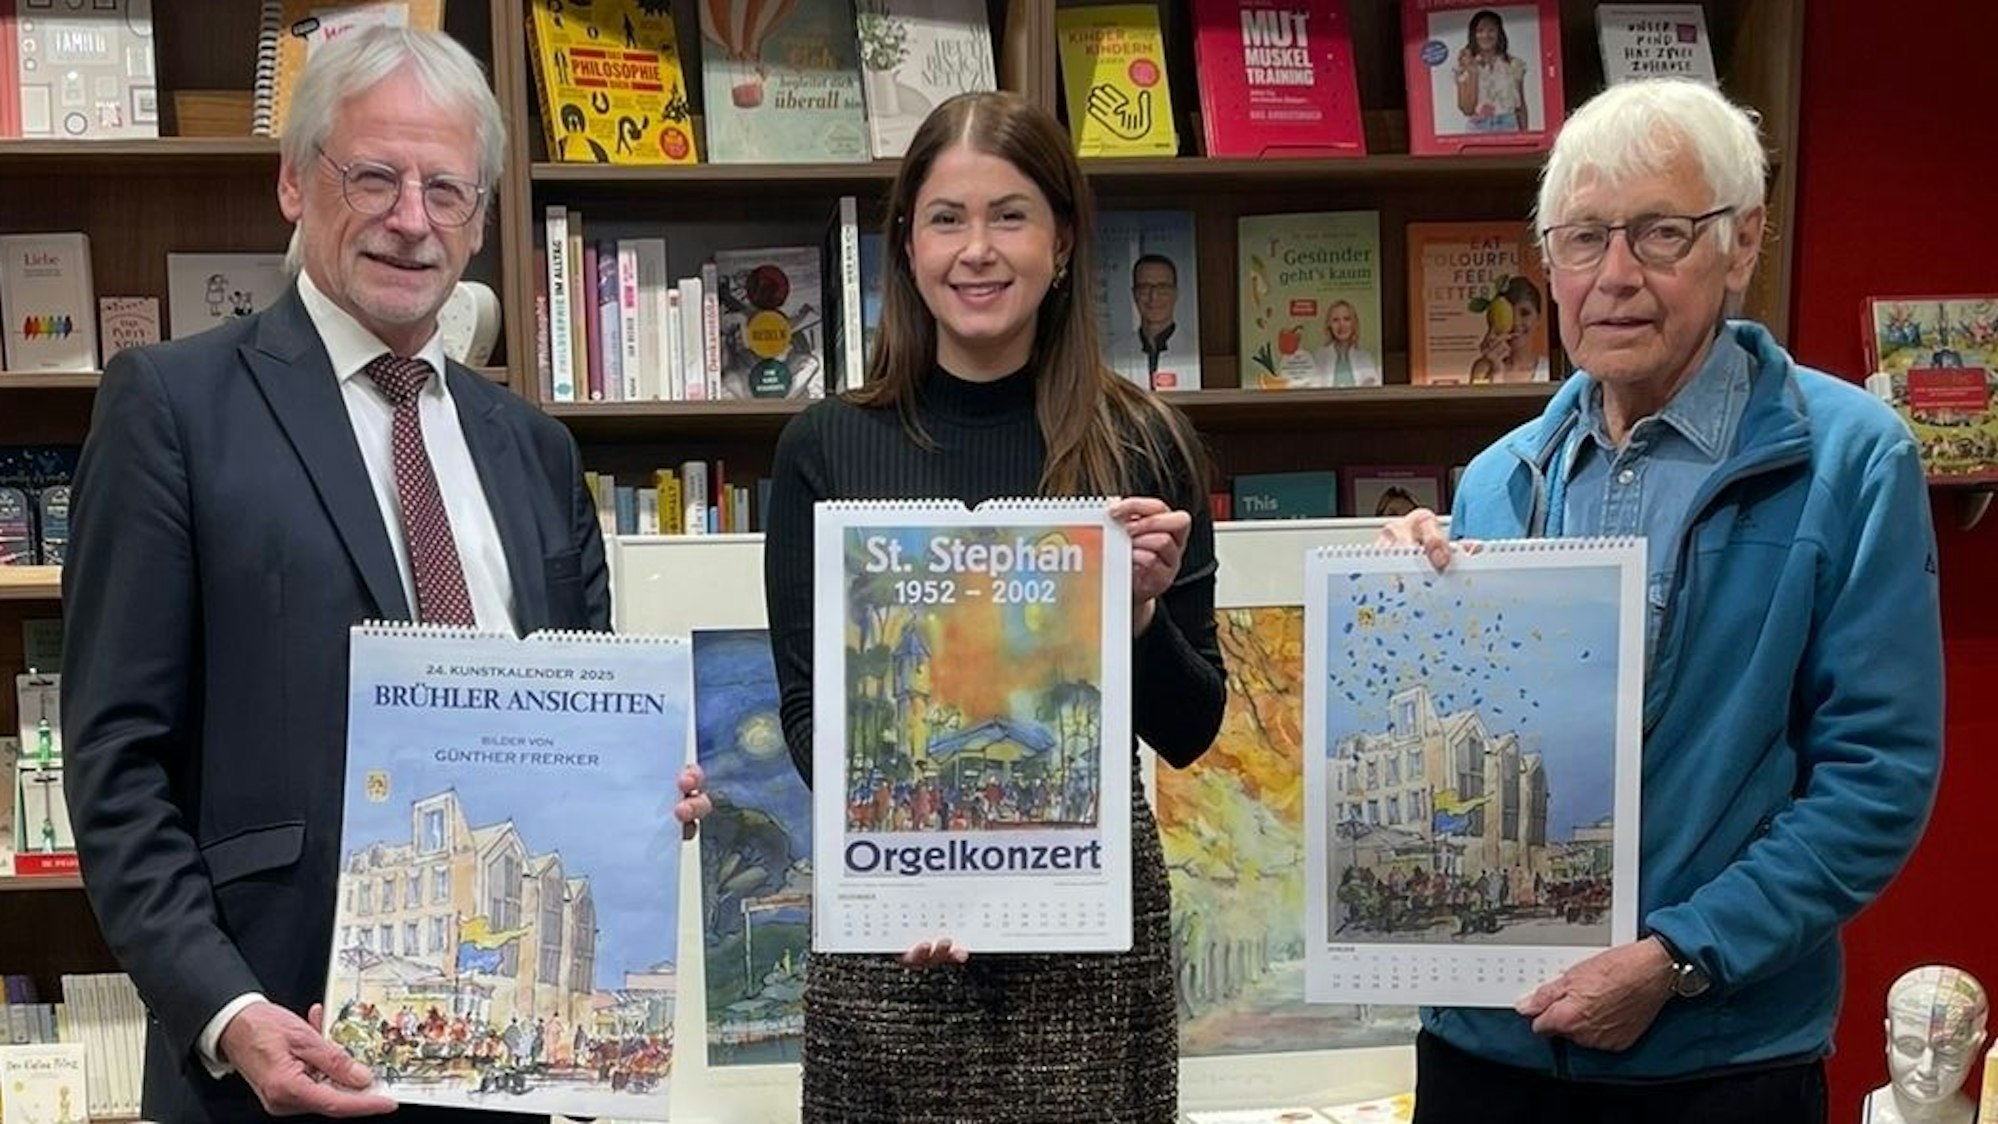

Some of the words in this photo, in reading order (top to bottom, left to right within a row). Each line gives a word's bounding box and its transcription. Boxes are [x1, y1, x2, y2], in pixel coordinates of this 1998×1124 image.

[1240, 9, 1309, 47] MUT
[1244, 48, 1314, 67] MUSKEL
[571, 59, 663, 81] PHILOSOPHIE
[1246, 68, 1315, 86] TRAINING
[775, 90, 840, 109] überall
[1471, 236, 1501, 250] EAT
[24, 252, 61, 267] Liebe
[552, 239, 563, 279] ALLTAG
[1283, 246, 1372, 266] Gesünder
[1279, 268, 1325, 286] geht's
[1329, 266, 1372, 280] kaum
[1453, 269, 1496, 283] FEEL
[553, 282, 564, 296] IM
[555, 299, 568, 374] PHILOSOPHIE
[1242, 495, 1279, 513] This
[865, 535, 912, 573] St.
[928, 535, 1083, 577] Stephan
[894, 580, 956, 603] 1952
[991, 580, 1056, 603] 2002
[426, 664, 448, 677] 24.
[449, 665, 574, 680] KUNSTKALENDER
[579, 669, 615, 681] 2025
[374, 682, 501, 710] BRÜHLER
[507, 689, 666, 715] ANSICHTEN
[481, 735, 525, 747] BILDER
[528, 737, 554, 747] VON
[434, 746, 516, 764] GÜNTHER
[519, 752, 600, 767] FRERKER
[844, 839, 1102, 876] Orgelkonzert
